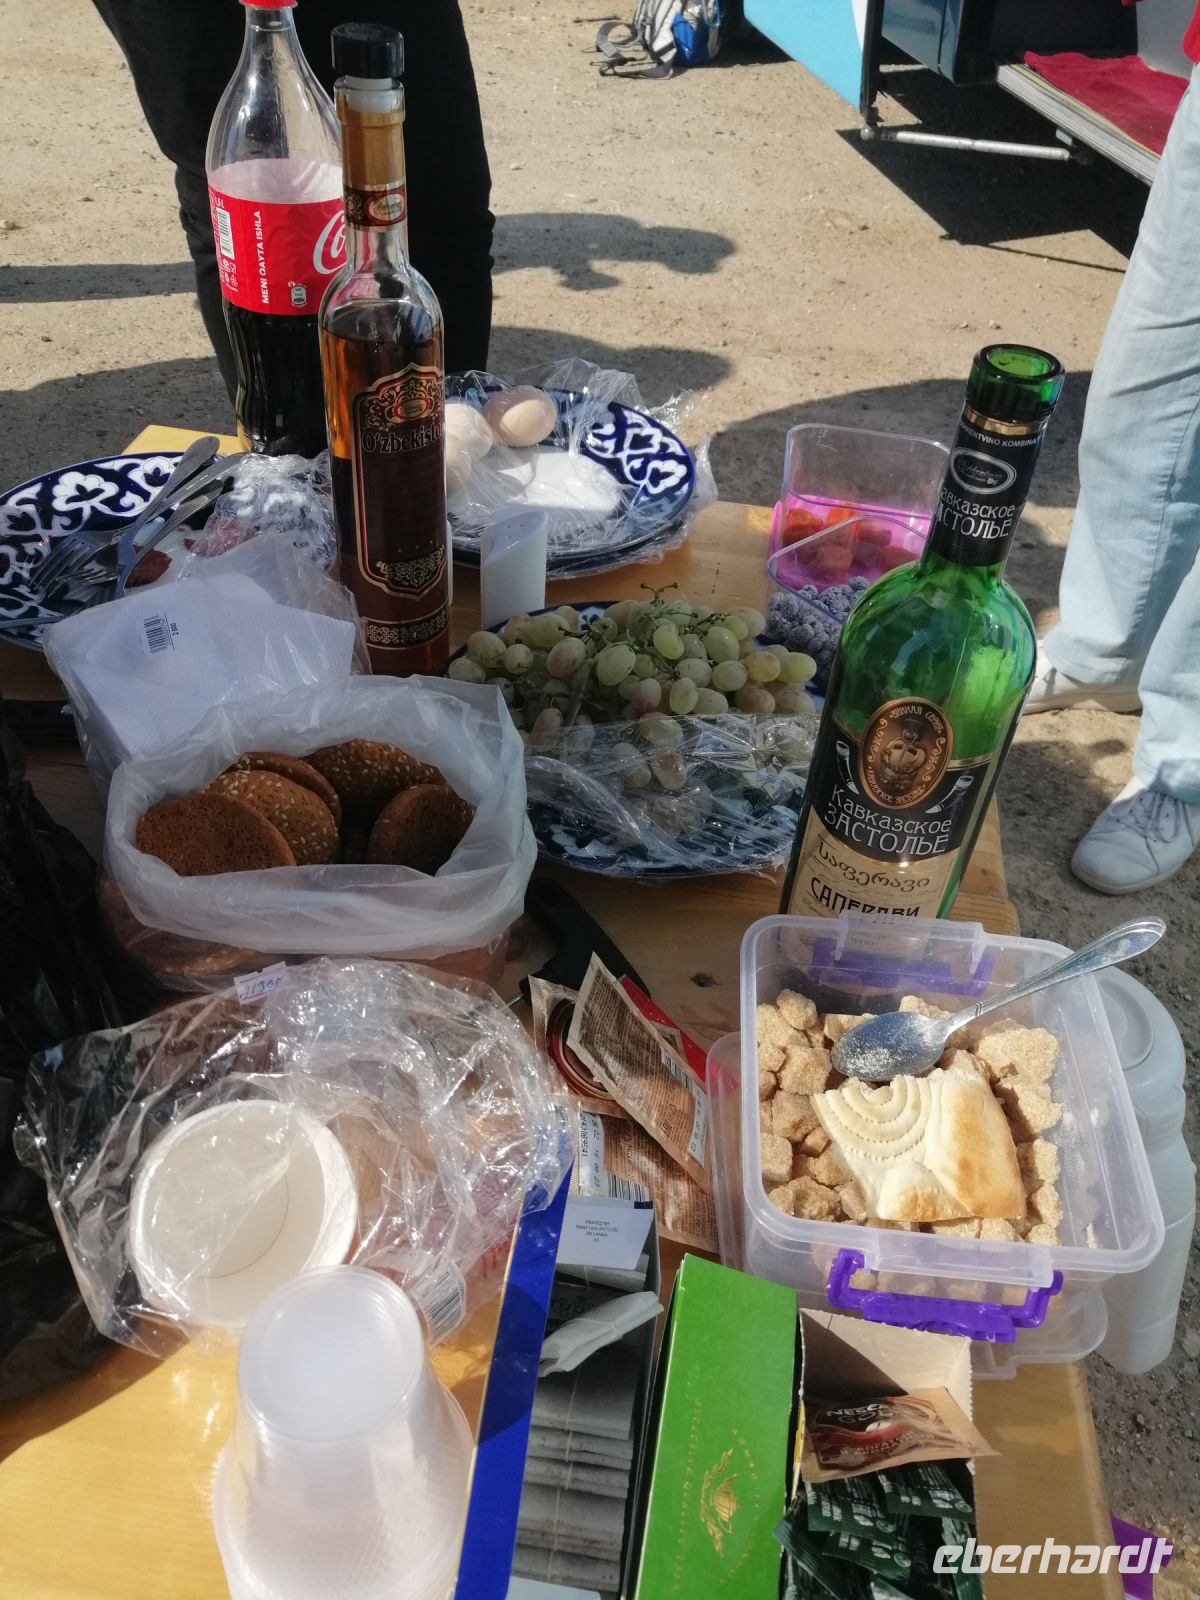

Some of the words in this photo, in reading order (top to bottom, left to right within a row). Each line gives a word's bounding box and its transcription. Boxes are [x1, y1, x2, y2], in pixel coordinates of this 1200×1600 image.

[254, 210, 263, 240] ISHLA
[256, 242, 267, 276] QAYTA
[260, 278, 270, 304] MENI
[941, 488, 1016, 519] авказское
[825, 804, 949, 855] ЗАСТОЛЬЕ
